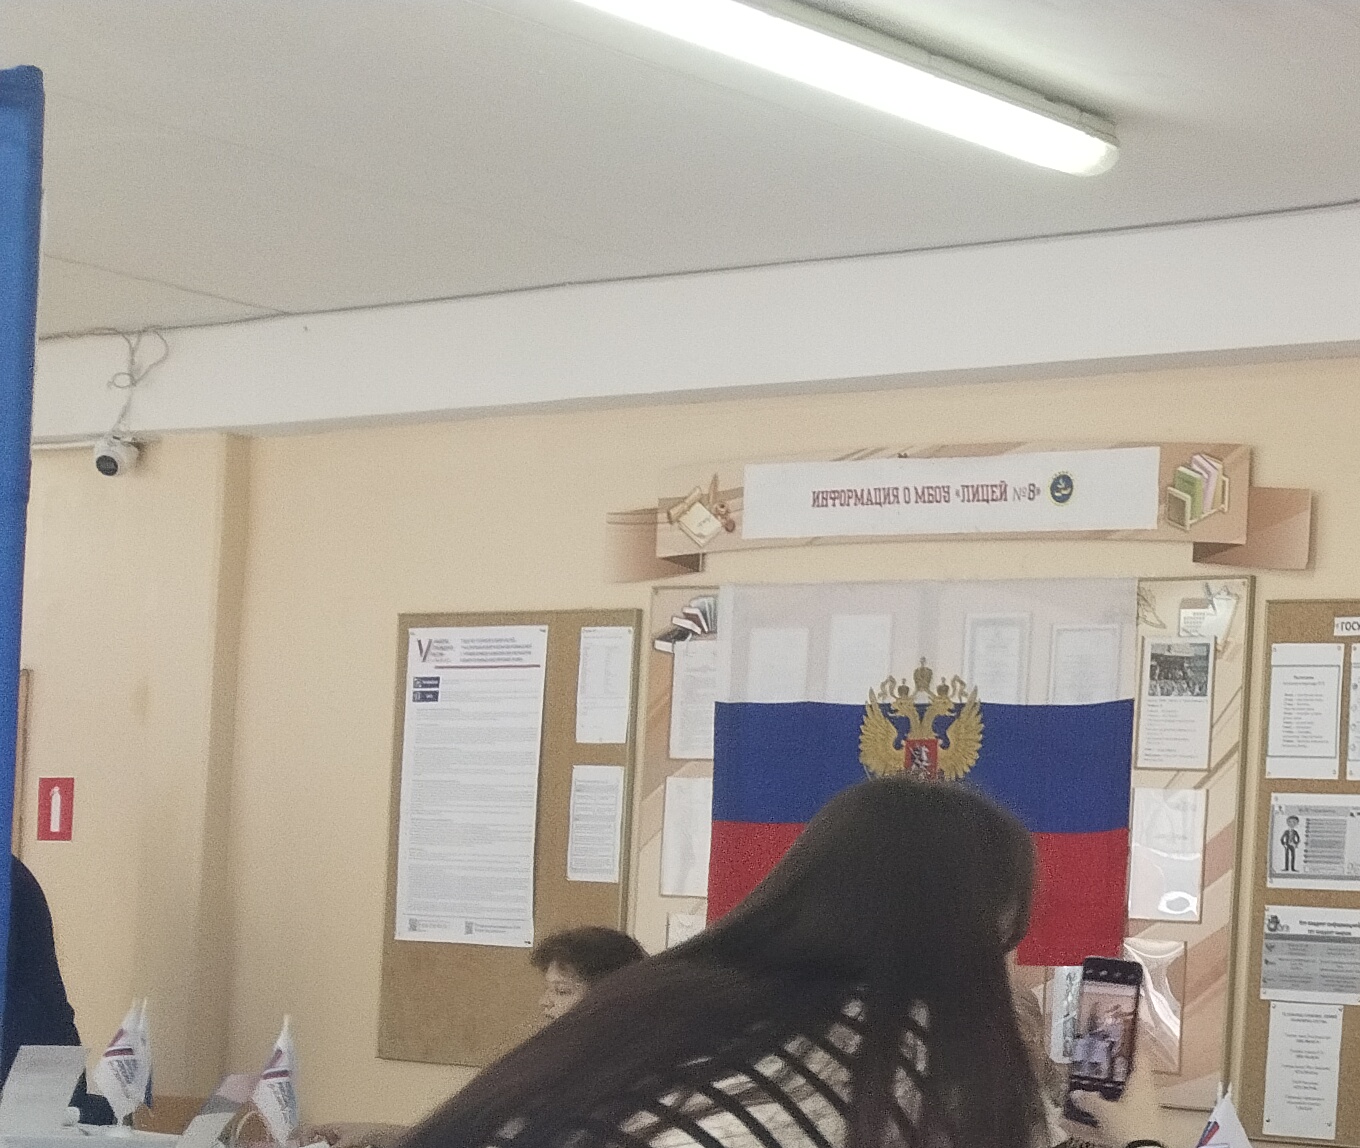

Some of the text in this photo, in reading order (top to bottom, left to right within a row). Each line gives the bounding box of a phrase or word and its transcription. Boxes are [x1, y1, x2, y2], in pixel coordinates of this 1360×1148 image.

[811, 486, 900, 508] ИНФОРМАЦИЯ
[903, 485, 911, 505] О
[913, 483, 951, 504] МБОУ
[955, 480, 1008, 504] «ЛИЦЕЙ
